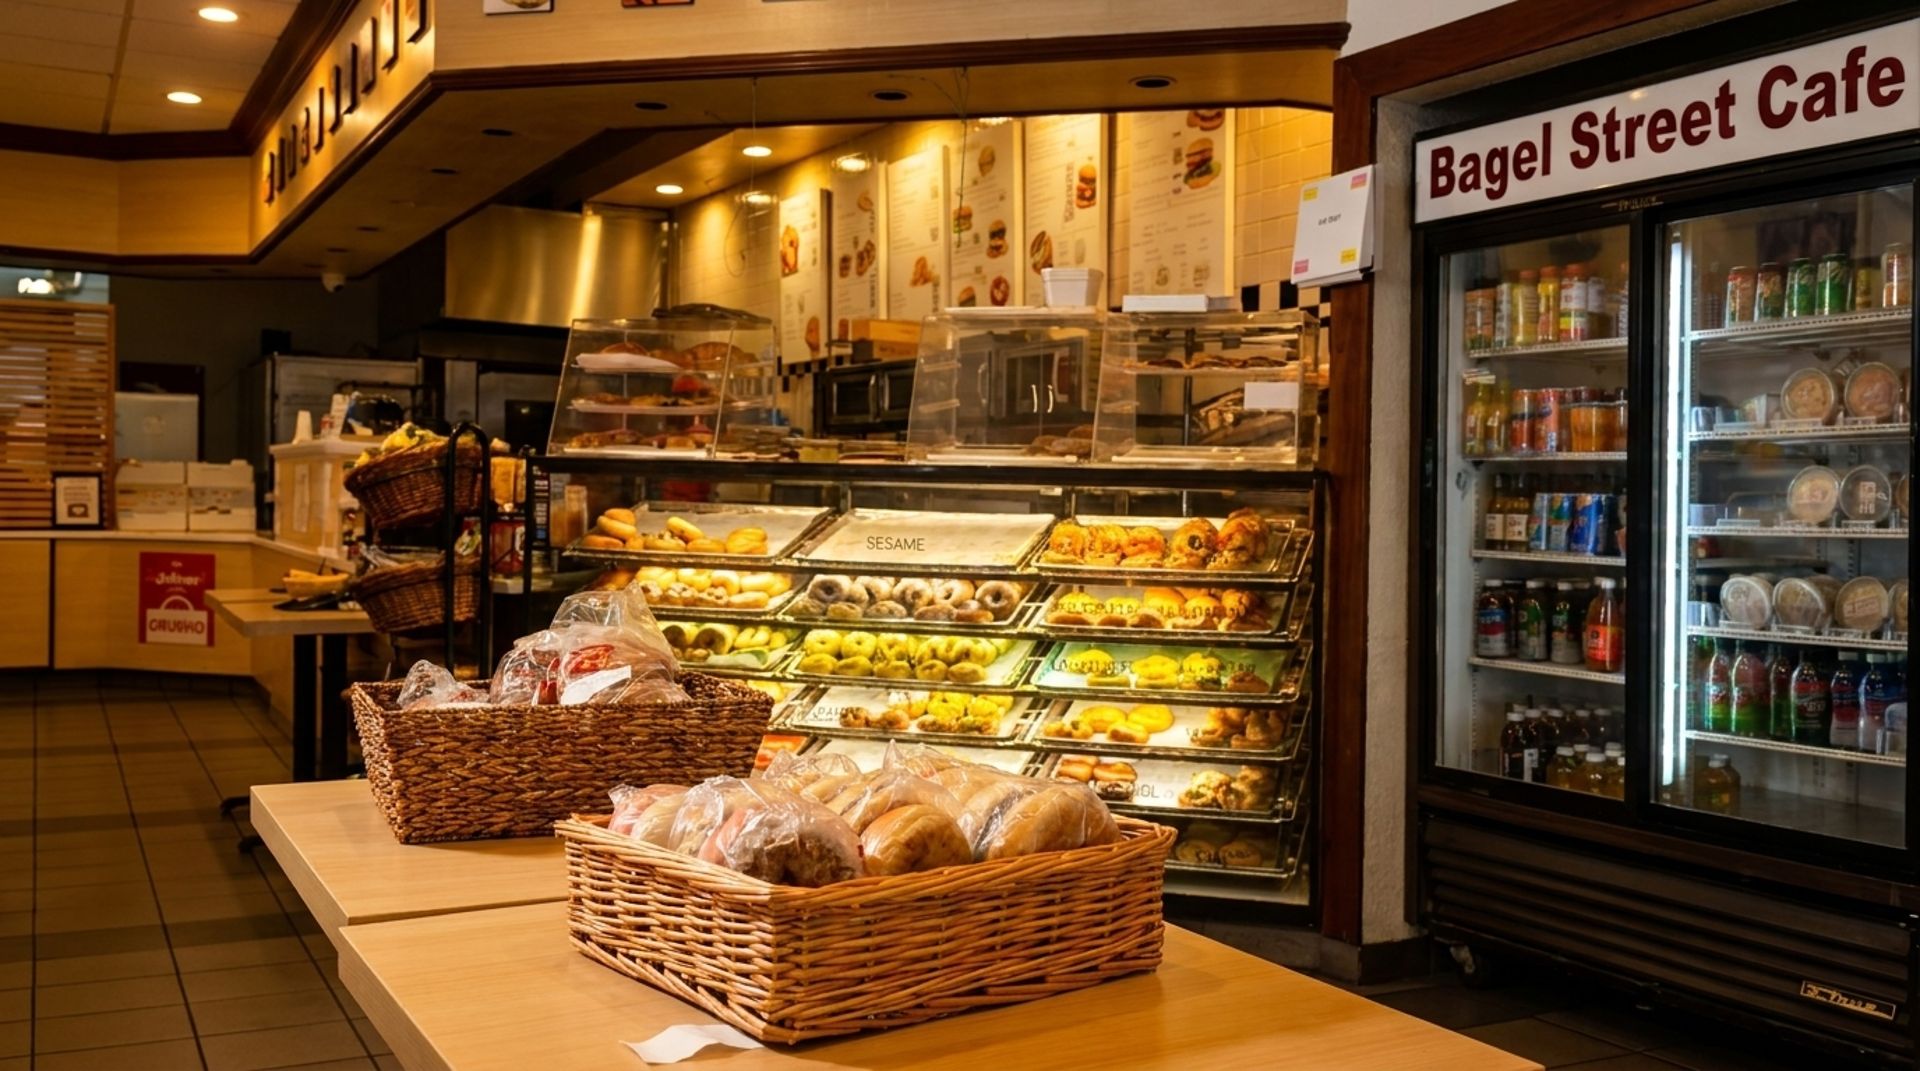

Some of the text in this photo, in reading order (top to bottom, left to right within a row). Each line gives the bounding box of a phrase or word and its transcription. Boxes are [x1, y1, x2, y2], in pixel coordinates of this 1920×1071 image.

[1430, 46, 1906, 202] Bagel Street Cafe
[866, 535, 926, 552] SESAME
